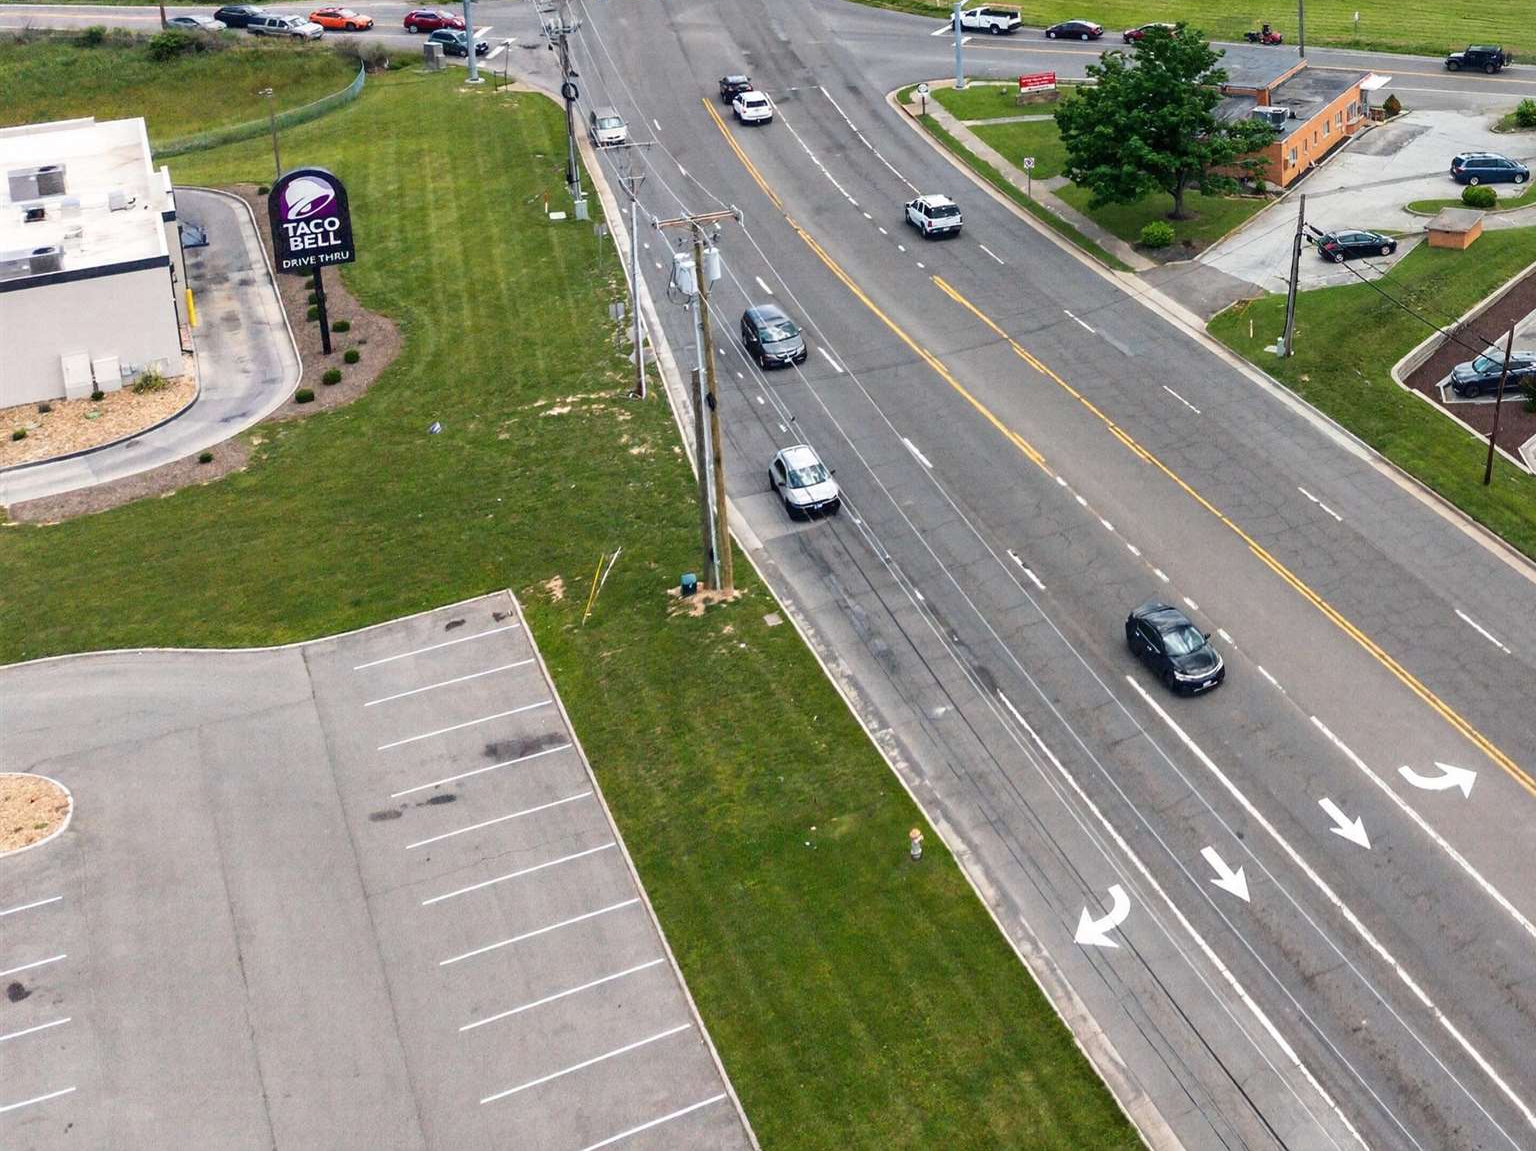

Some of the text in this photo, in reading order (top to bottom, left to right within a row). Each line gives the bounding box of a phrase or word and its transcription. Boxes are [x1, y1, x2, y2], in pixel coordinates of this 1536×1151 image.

[283, 217, 340, 237] TACO
[289, 231, 342, 251] BELL
[282, 250, 350, 269] DRIVE THRU
